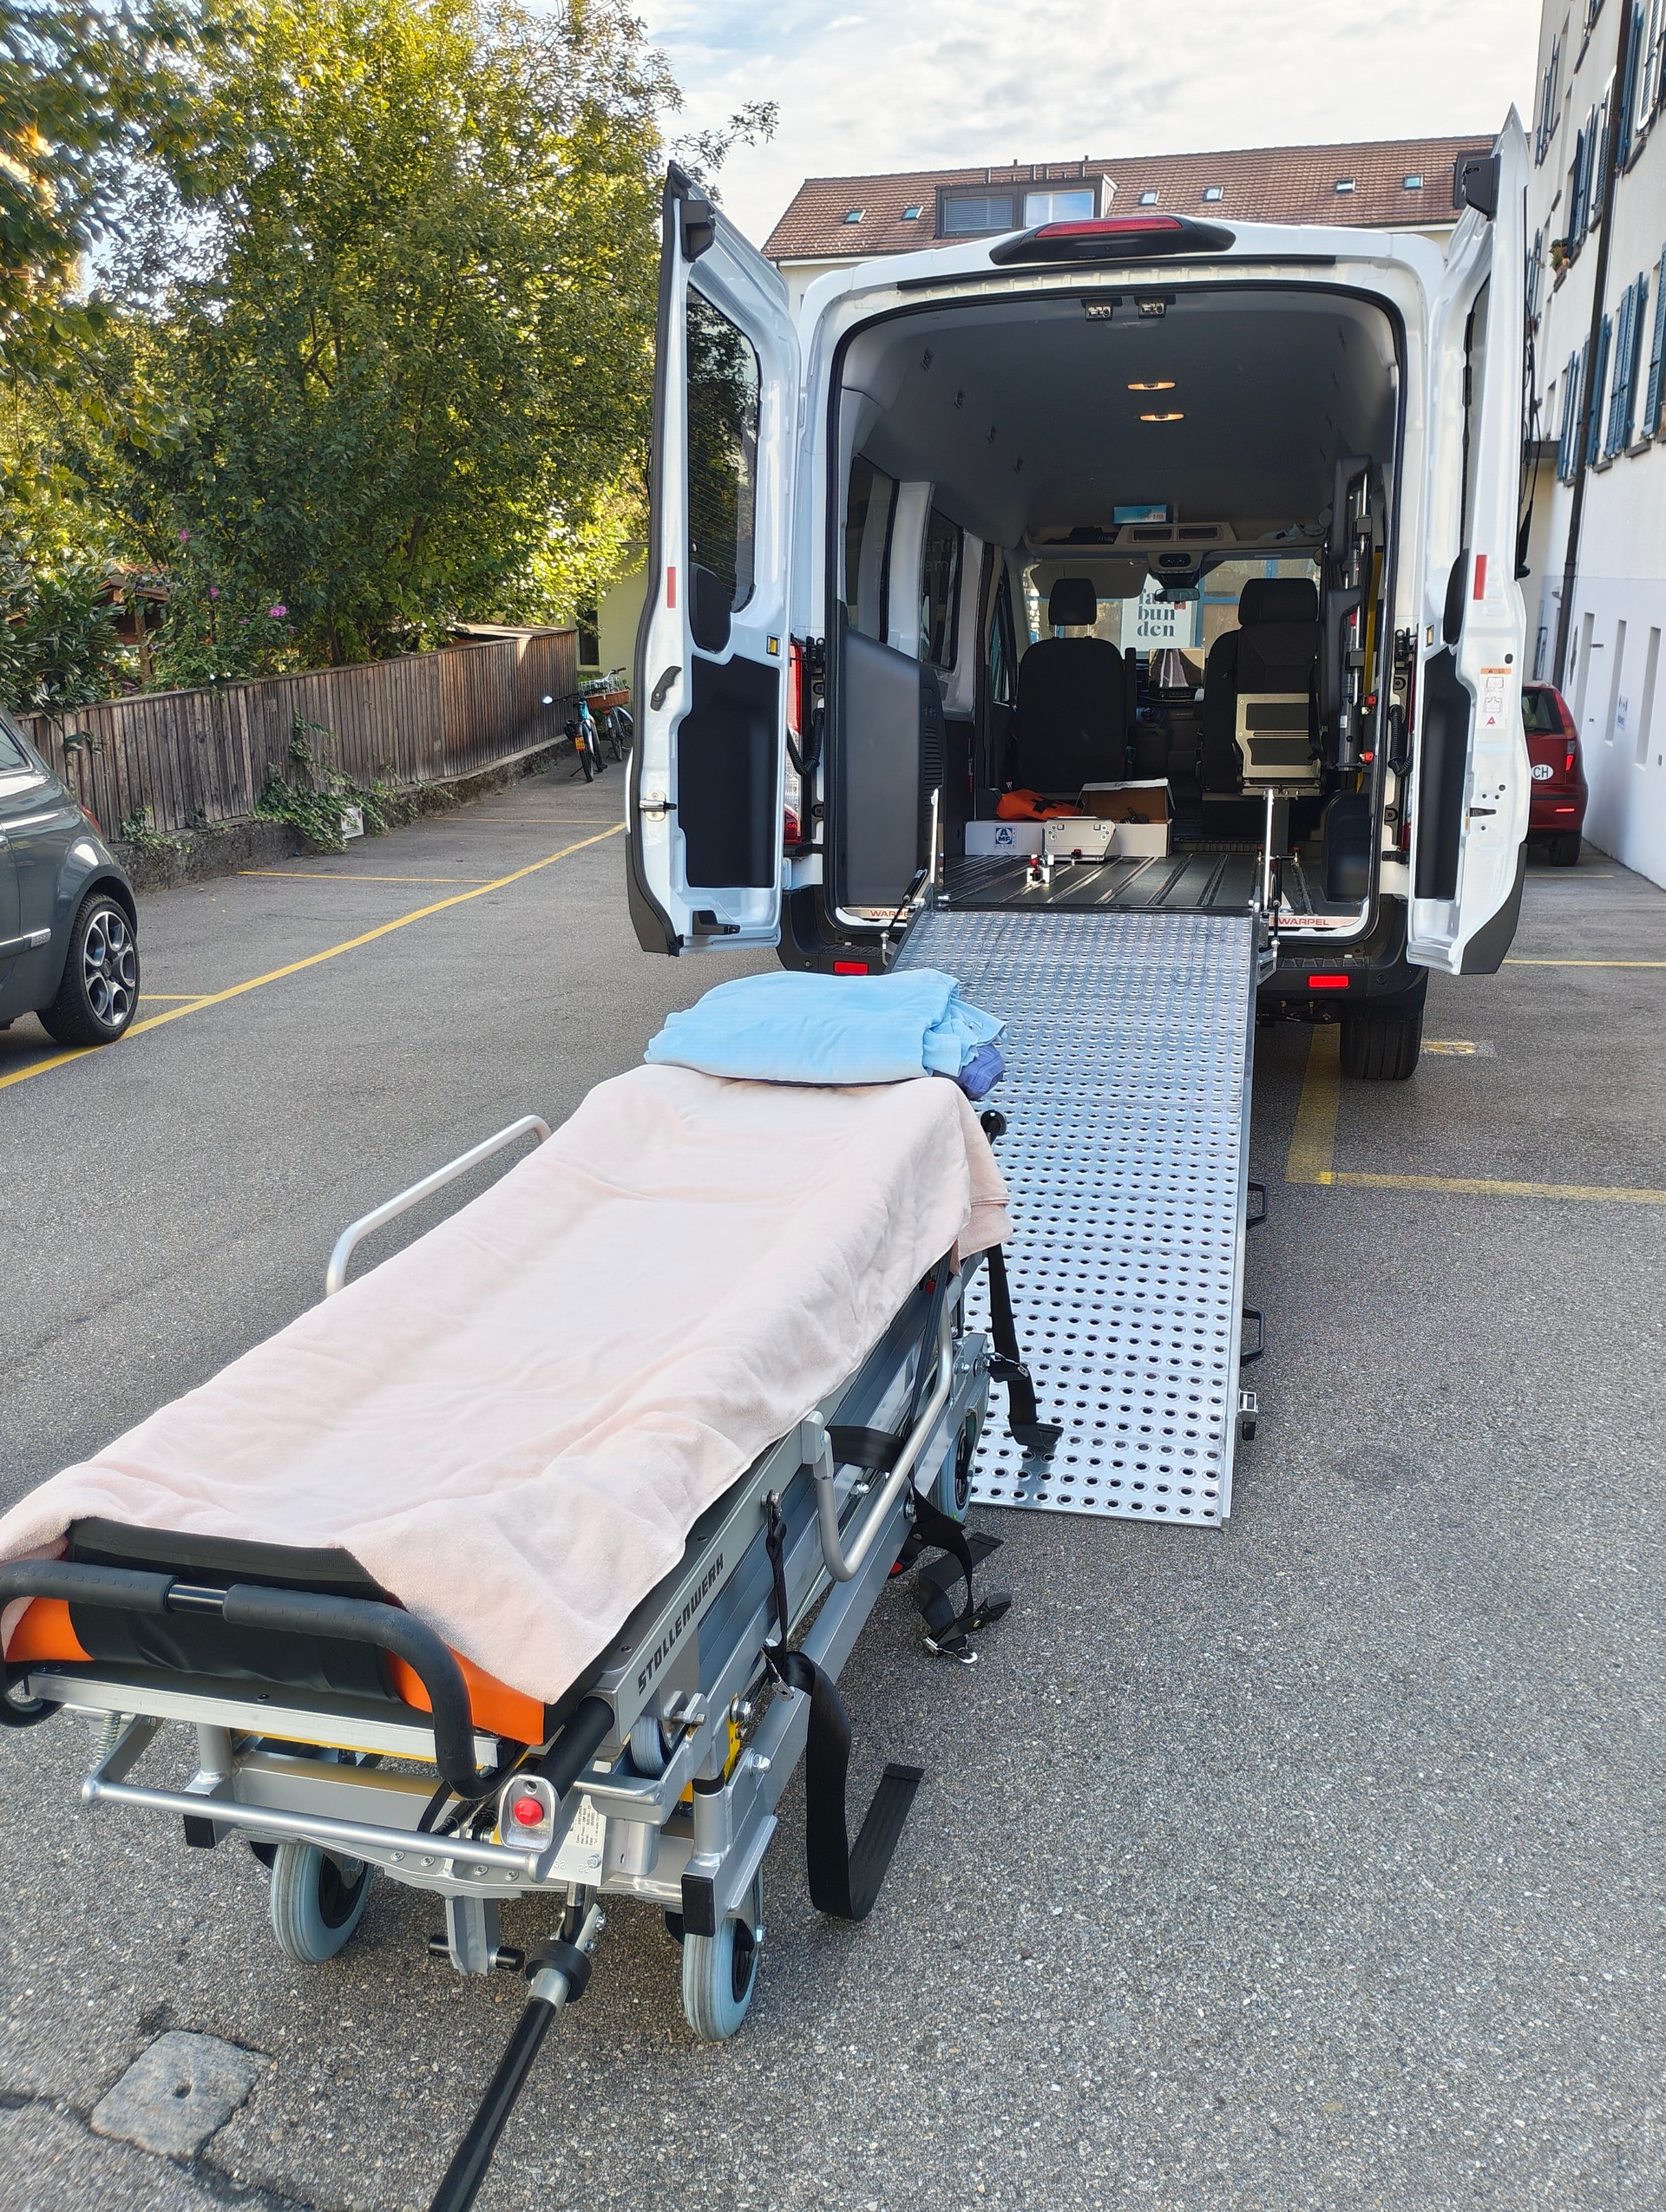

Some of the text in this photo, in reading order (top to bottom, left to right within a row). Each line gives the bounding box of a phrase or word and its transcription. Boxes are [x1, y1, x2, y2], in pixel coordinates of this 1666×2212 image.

[1138, 606, 1176, 620] bun
[1137, 621, 1175, 637] den
[1533, 766, 1549, 778] CH
[638, 1551, 725, 1697] STOLLENWERK
